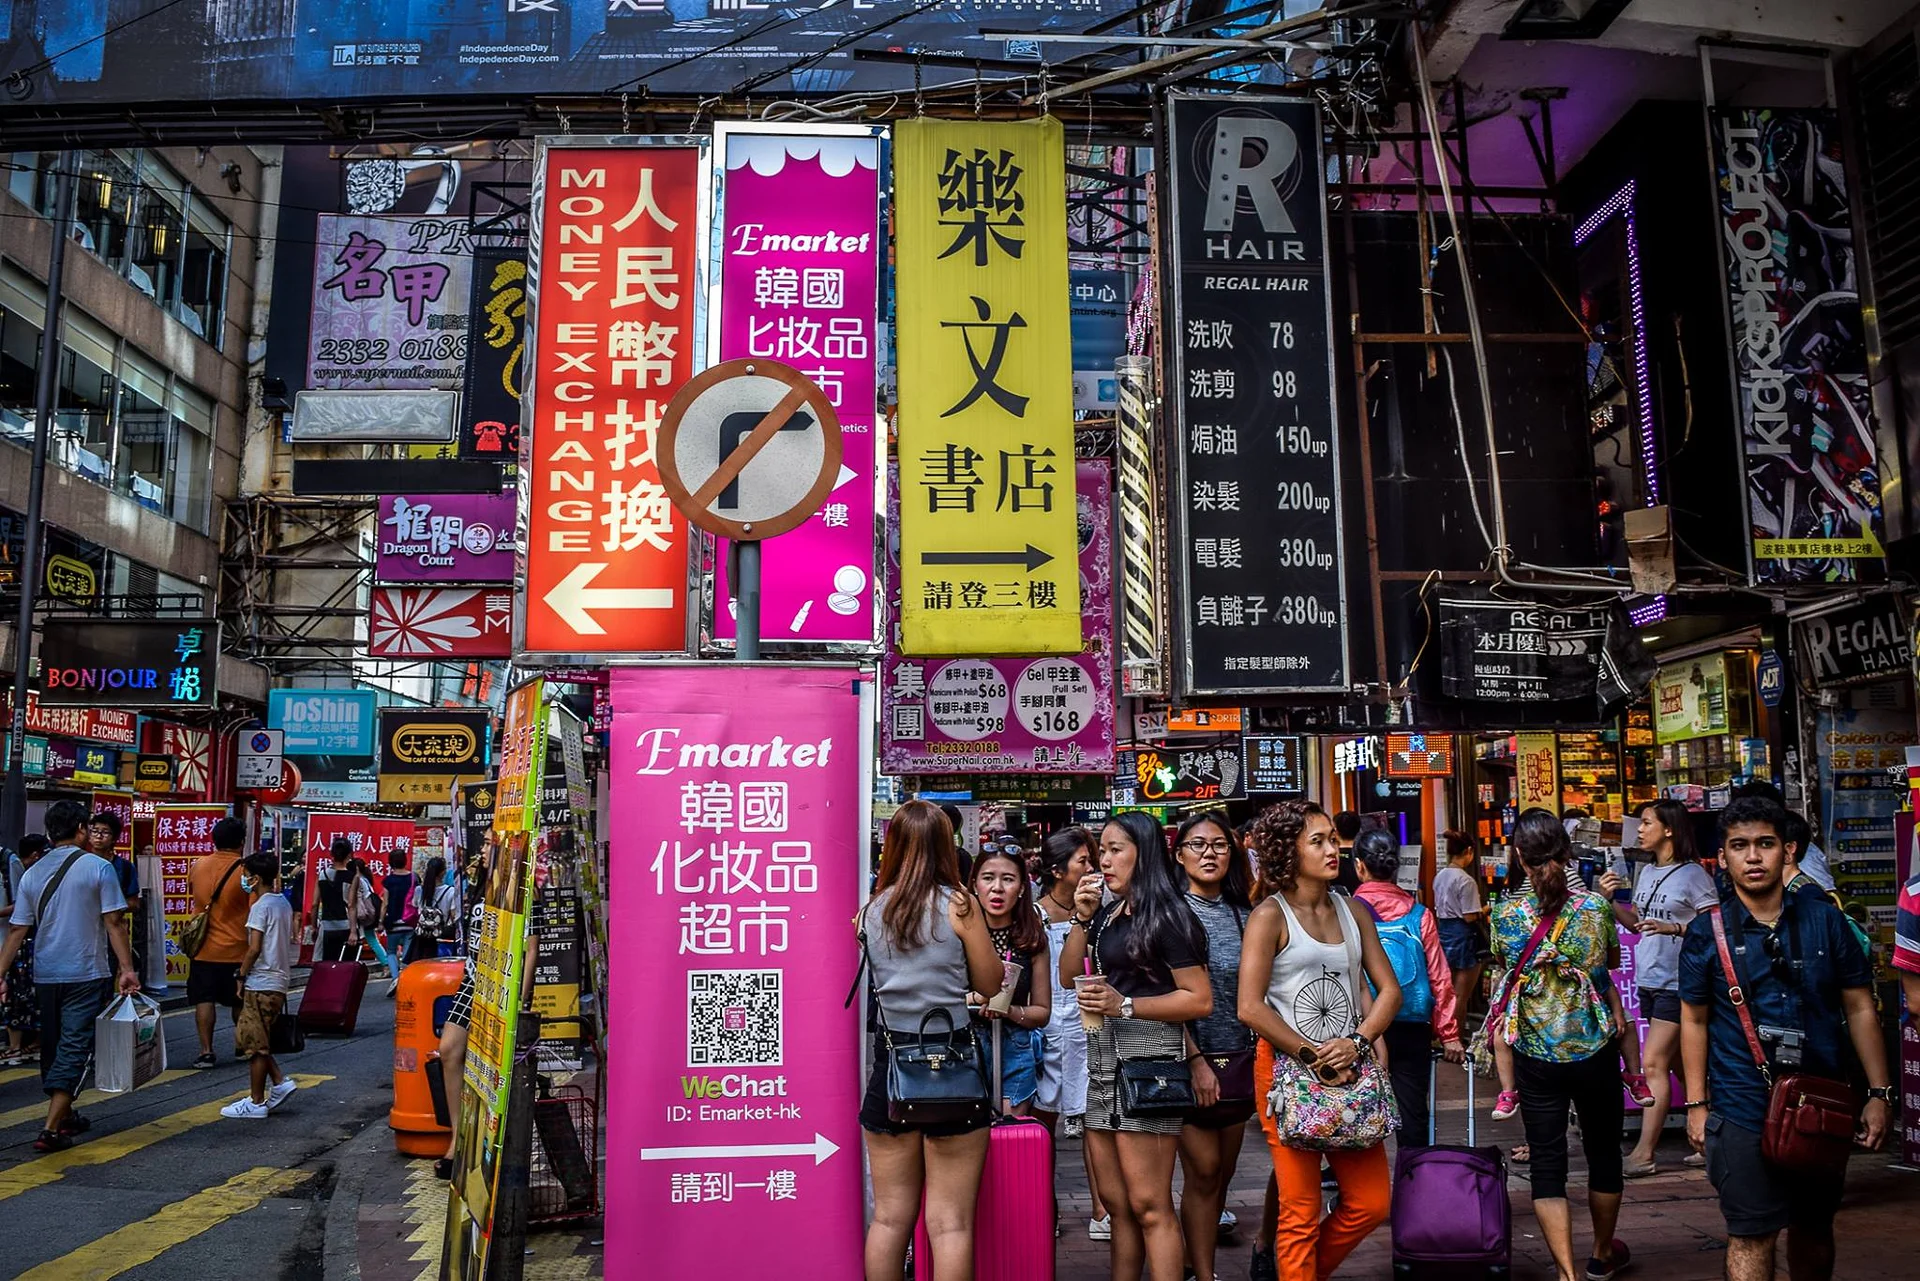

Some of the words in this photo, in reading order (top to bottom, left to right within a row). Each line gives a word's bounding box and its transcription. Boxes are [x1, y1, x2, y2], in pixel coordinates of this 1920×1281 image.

[460, 44, 549, 53] #IndependenceDay
[557, 169, 606, 301] MONEY
[732, 224, 870, 256] Emarket
[1206, 239, 1306, 260] HAIR
[323, 231, 450, 327] 名甲
[754, 266, 844, 309] 韓國
[1204, 277, 1261, 290] REGAL
[1265, 278, 1309, 291] HAIR
[1070, 283, 1117, 302] 中心
[1187, 320, 1234, 350] 洗吹
[1270, 322, 1294, 349] 78
[317, 339, 390, 365] 2332
[601, 168, 680, 552] 人民幣找換
[1190, 369, 1236, 399] 洗剪
[1273, 371, 1297, 398] 98
[548, 323, 598, 552] EXCHANGE
[1191, 424, 1238, 455] 焗油
[919, 443, 1056, 513] 書店
[1193, 481, 1241, 511] 染髮
[383, 543, 428, 556] Dragon
[419, 554, 454, 566] Court
[1195, 538, 1243, 568] 電髮
[922, 580, 1057, 610] 請登三樓
[1196, 595, 1268, 626] 負離子
[1809, 612, 1907, 678] REGAL
[1224, 656, 1311, 671] 指定髮型師除外
[1860, 646, 1913, 671] HAIR
[48, 668, 157, 692] BONJOUR
[1027, 668, 1045, 681] Gel
[1760, 667, 1780, 690] ADT
[979, 683, 1006, 699] $68
[1052, 684, 1069, 694] (Full
[1072, 684, 1088, 694] Set)
[1475, 689, 1511, 698] 12:00pm
[99, 710, 129, 726] MONEY
[282, 697, 359, 722] JoShin
[1033, 711, 1080, 732] $168
[91, 724, 134, 743] EXCHANGE
[976, 717, 1004, 733] $98
[266, 758, 273, 769] 7
[636, 728, 832, 775] Emarket
[911, 755, 1014, 767] www.SuperNail.com.hk
[265, 775, 279, 787] 12
[1195, 785, 1219, 798] 2/F
[547, 809, 571, 823] 4/F
[680, 780, 788, 834] 韓國
[650, 841, 818, 894] 化妝品
[678, 900, 790, 956] 超市
[539, 942, 573, 951] BUFFET
[680, 1074, 787, 1099] WeChat
[666, 1105, 692, 1122] ID:
[700, 1103, 801, 1121] Emarket-hk
[671, 1169, 798, 1203] 請到一樓
